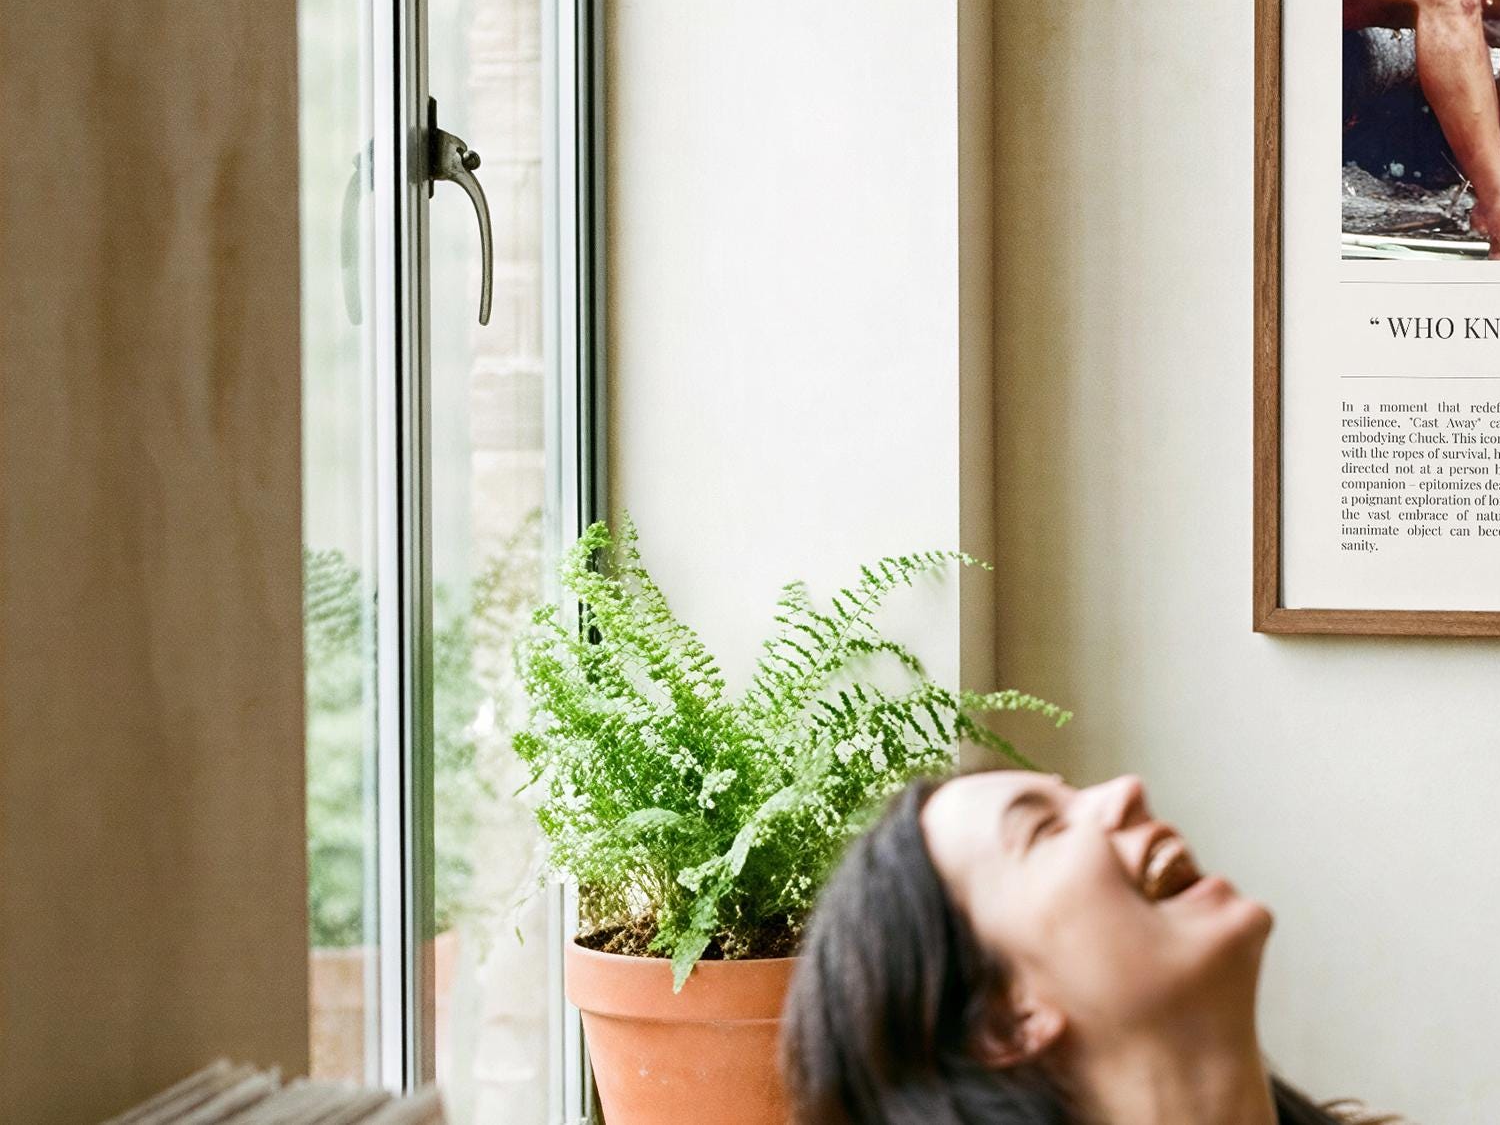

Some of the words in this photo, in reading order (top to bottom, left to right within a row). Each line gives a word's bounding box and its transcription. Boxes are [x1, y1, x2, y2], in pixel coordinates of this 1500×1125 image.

[1386, 316, 1455, 340] WHO
[1341, 400, 1354, 413] In
[1362, 403, 1370, 413] a
[1379, 402, 1428, 413] moment
[1437, 400, 1461, 414] that
[1340, 431, 1406, 446] embodying
[1451, 432, 1478, 445] This
[1340, 446, 1368, 459] with
[1370, 446, 1390, 459] the
[1392, 450, 1425, 462] ropes
[1427, 447, 1441, 460] of
[1340, 462, 1390, 475] directed
[1394, 463, 1415, 475] not
[1419, 464, 1432, 475] at
[1436, 466, 1444, 475] a
[1448, 466, 1490, 477] person
[1340, 477, 1406, 492] companion
[1418, 478, 1483, 493] epitomizes
[1340, 495, 1349, 505] a
[1350, 493, 1403, 508] poignant
[1404, 493, 1472, 508] exploration
[1473, 494, 1487, 507] of
[1341, 507, 1361, 521] the
[1367, 509, 1391, 521] vast
[1397, 508, 1449, 521] embrace
[1455, 509, 1470, 522] of
[1341, 523, 1400, 536] inanimate
[1406, 524, 1442, 539] object
[1449, 527, 1471, 537] can
